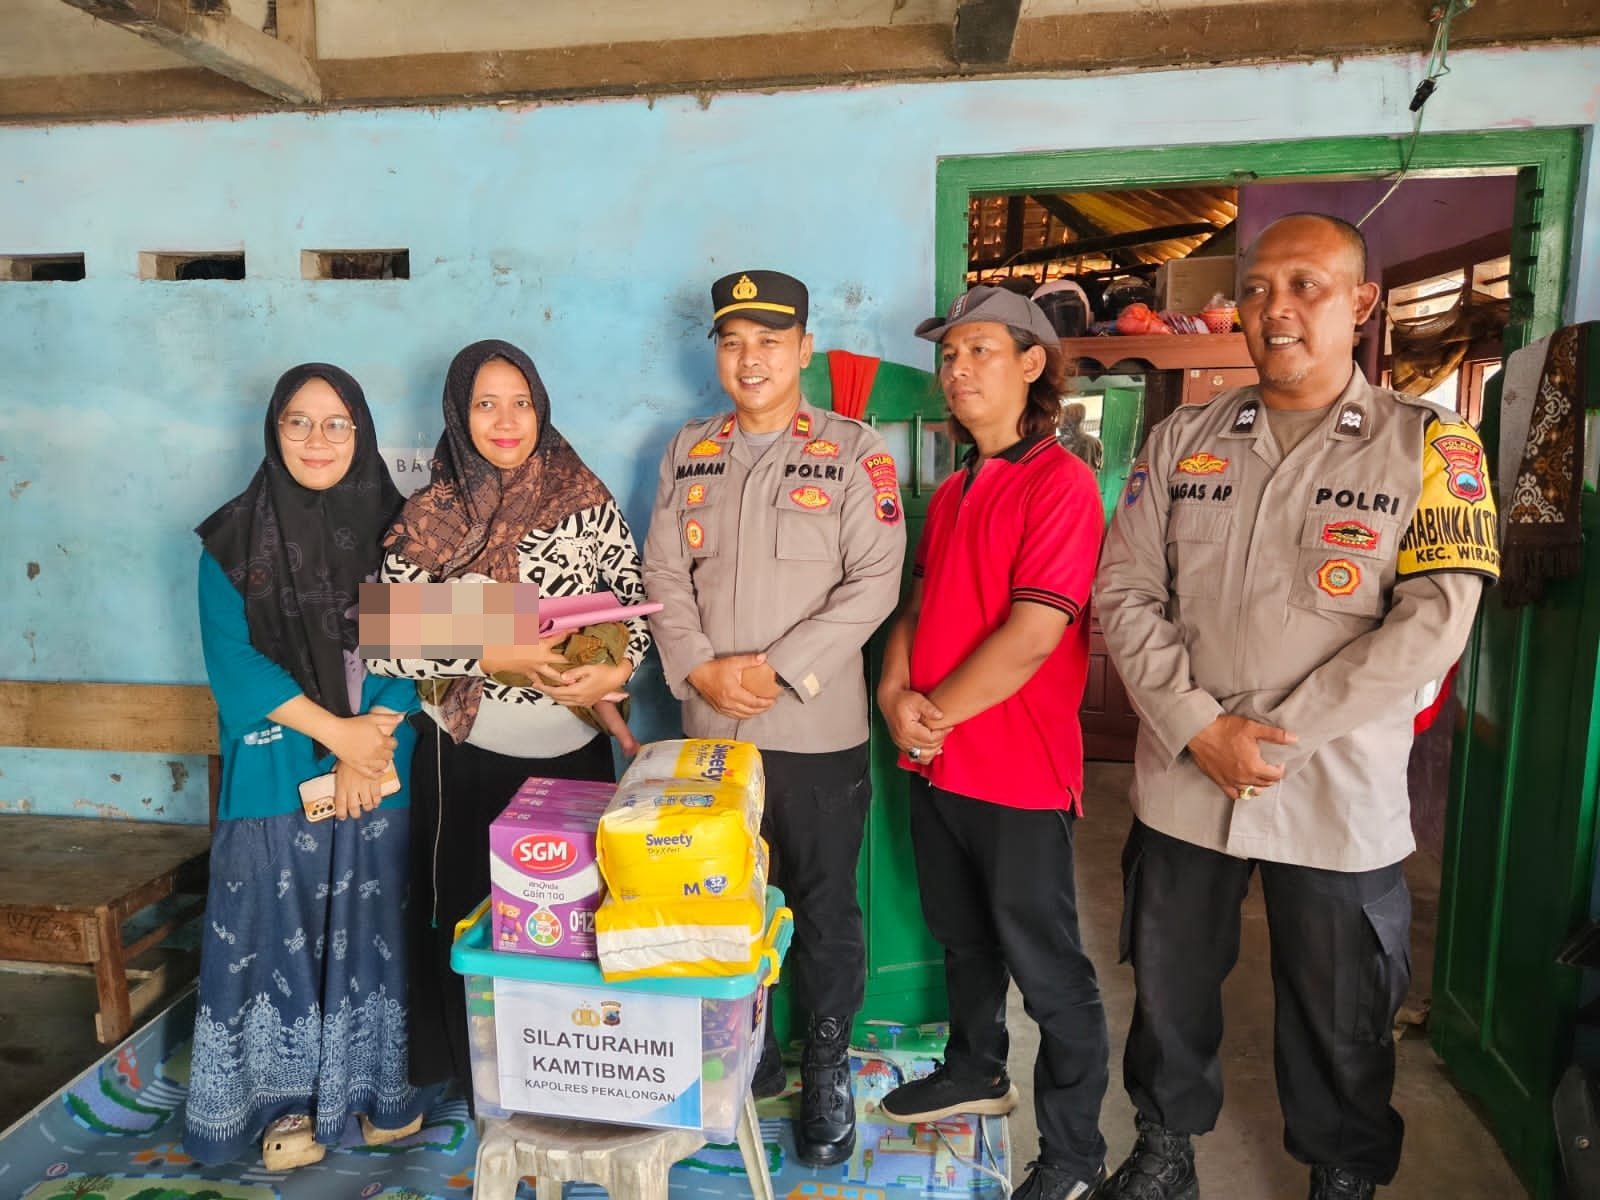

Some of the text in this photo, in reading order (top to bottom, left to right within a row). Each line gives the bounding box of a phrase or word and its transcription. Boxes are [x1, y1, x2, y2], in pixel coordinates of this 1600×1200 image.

[675, 462, 726, 480] MAMAN
[784, 464, 844, 482] POLRI
[1211, 485, 1233, 501] AP
[1315, 488, 1399, 516] POLRI
[1416, 547, 1451, 563] KEC.
[701, 742, 736, 782] Sweety
[645, 833, 694, 848] Sweety
[519, 841, 567, 861] SGM
[522, 889, 565, 901] Gain 100
[683, 882, 701, 896] M
[523, 1028, 674, 1057] SILATURAHMI
[532, 1056, 666, 1083] KAMTIBMAS
[524, 1078, 676, 1103] KAPOLRES PEKALONGAN
